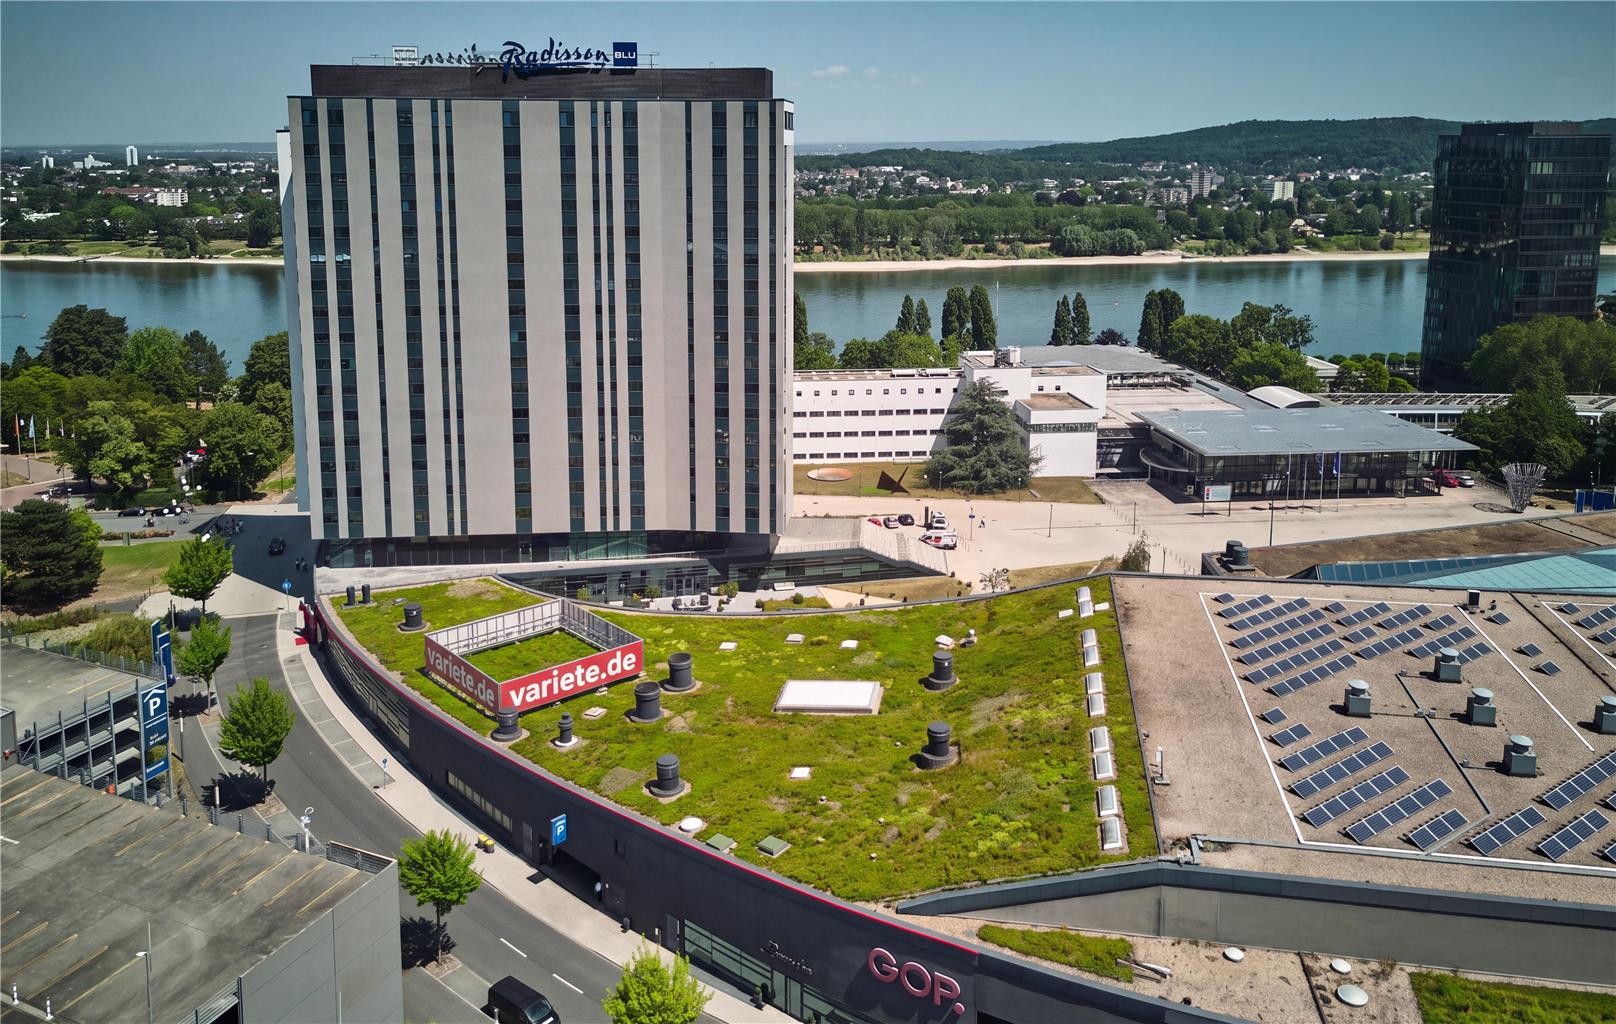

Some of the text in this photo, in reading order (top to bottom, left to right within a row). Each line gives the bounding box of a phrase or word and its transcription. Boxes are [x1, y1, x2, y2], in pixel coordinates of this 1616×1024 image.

[500, 37, 636, 83] Radisson BLU
[426, 647, 495, 707] variete.de
[509, 650, 638, 708] variete.de
[149, 697, 161, 717] P
[557, 825, 565, 836] P
